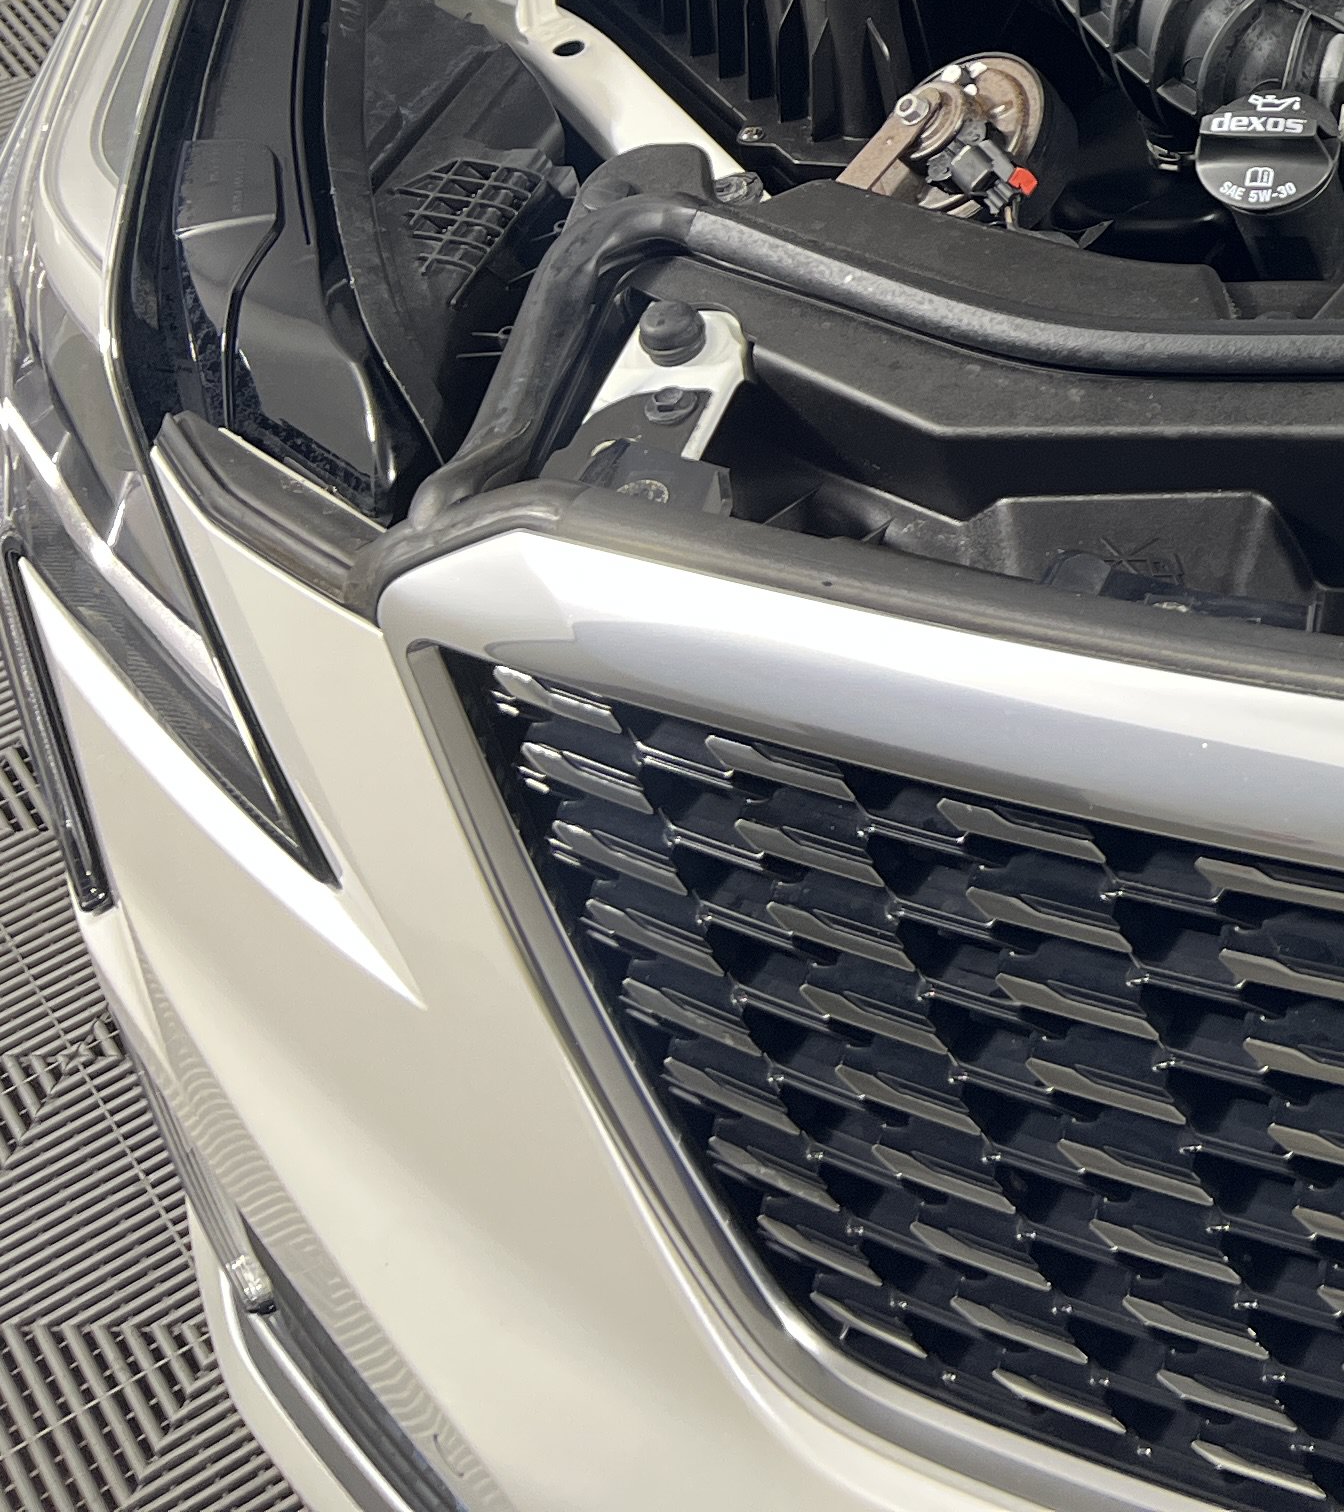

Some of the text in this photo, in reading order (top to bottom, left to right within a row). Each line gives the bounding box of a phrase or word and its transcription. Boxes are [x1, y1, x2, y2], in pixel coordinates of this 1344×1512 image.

[1210, 112, 1305, 134] dexos
[1219, 181, 1297, 203] SAE 5W-30
